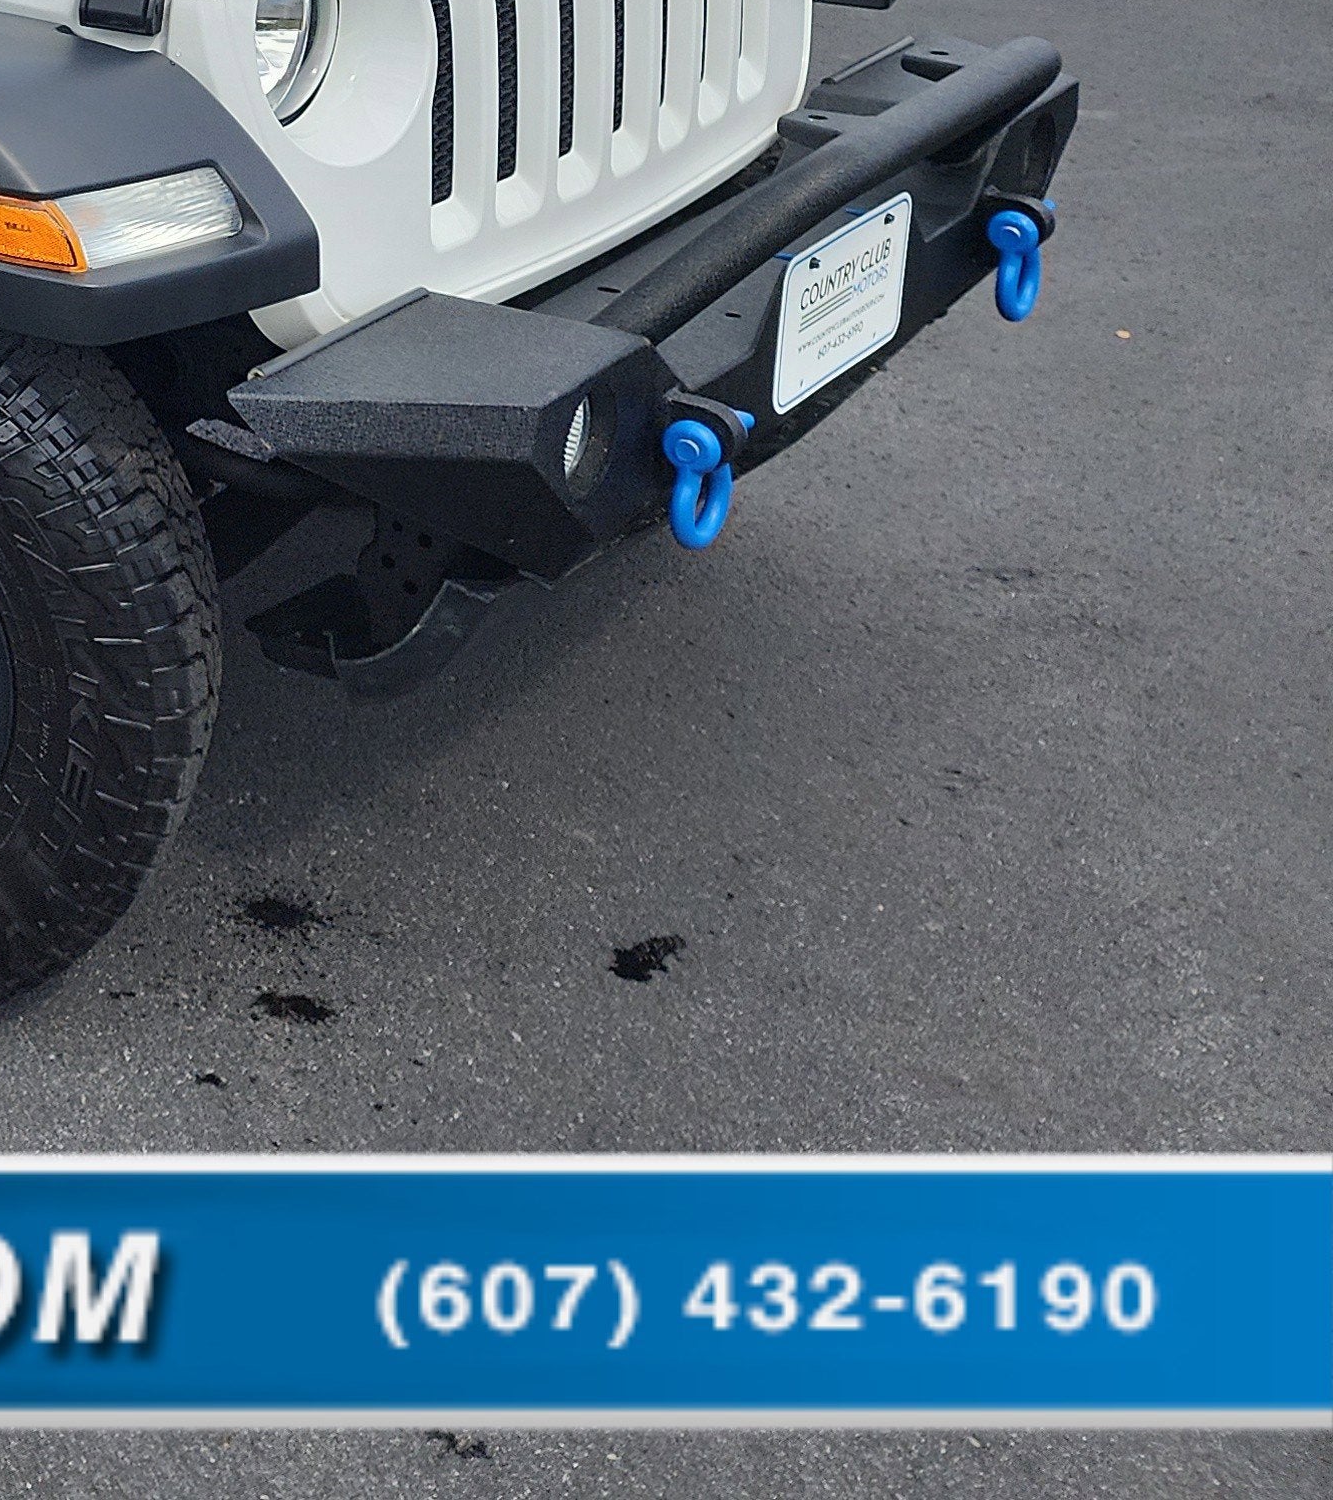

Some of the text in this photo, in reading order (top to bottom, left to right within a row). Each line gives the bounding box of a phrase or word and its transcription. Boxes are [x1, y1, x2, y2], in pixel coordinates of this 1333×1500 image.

[799, 238, 892, 311] COUNTRY CLUB
[851, 262, 890, 297] MOTORS
